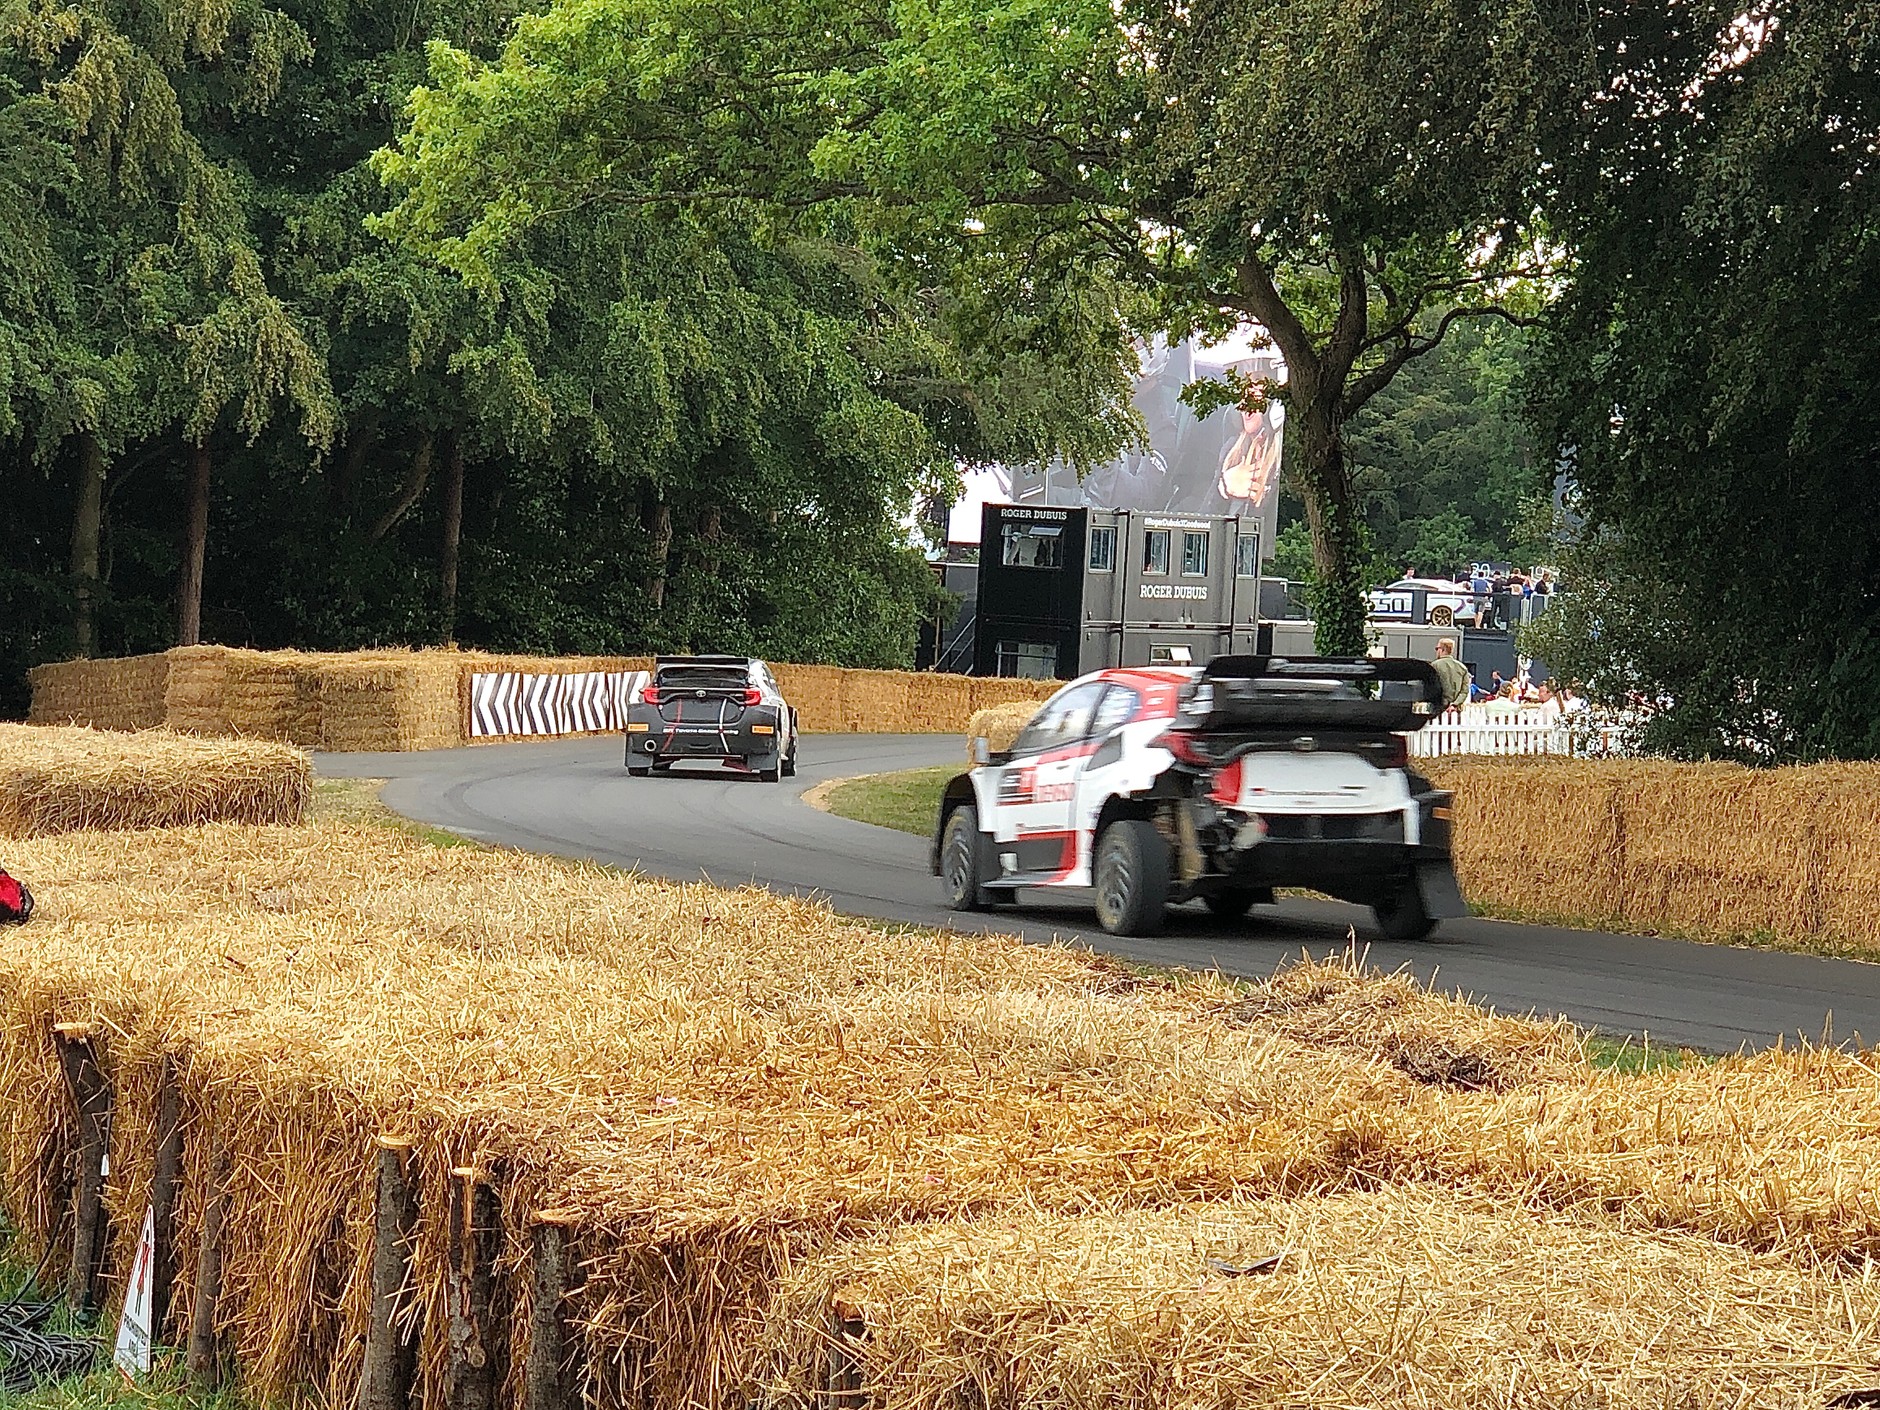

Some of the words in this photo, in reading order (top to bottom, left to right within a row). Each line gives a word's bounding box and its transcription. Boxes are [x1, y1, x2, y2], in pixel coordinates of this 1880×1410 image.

[1000, 508, 1032, 519] ROGER
[1033, 510, 1068, 520] DUBUIS
[1140, 584, 1173, 599] ROGER
[1173, 585, 1208, 600] DUBUIS
